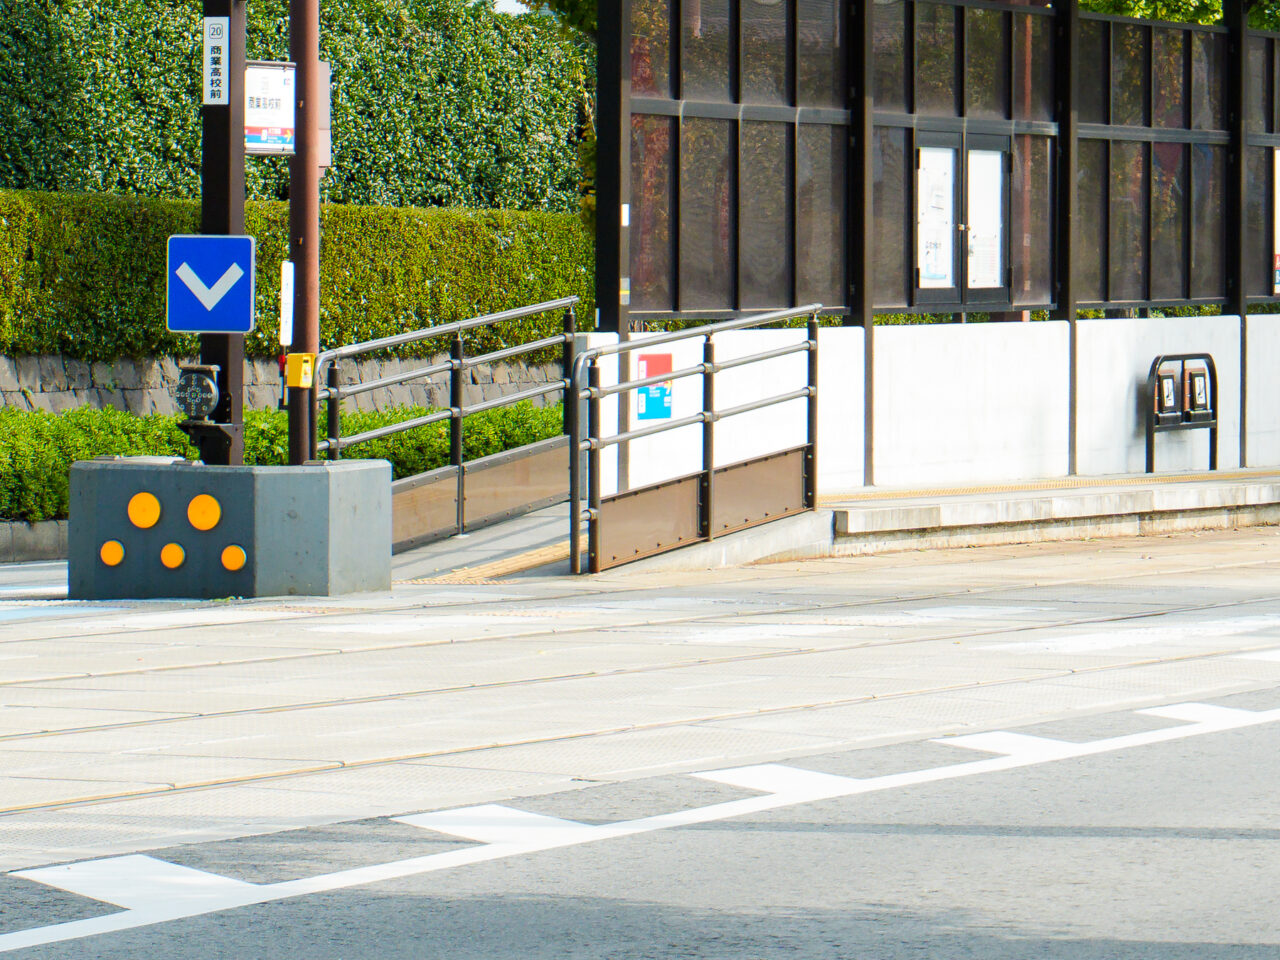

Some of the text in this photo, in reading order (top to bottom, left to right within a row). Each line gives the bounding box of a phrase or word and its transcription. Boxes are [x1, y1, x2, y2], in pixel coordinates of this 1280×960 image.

[210, 26, 221, 36] 20
[210, 45, 222, 99] 商業高校前
